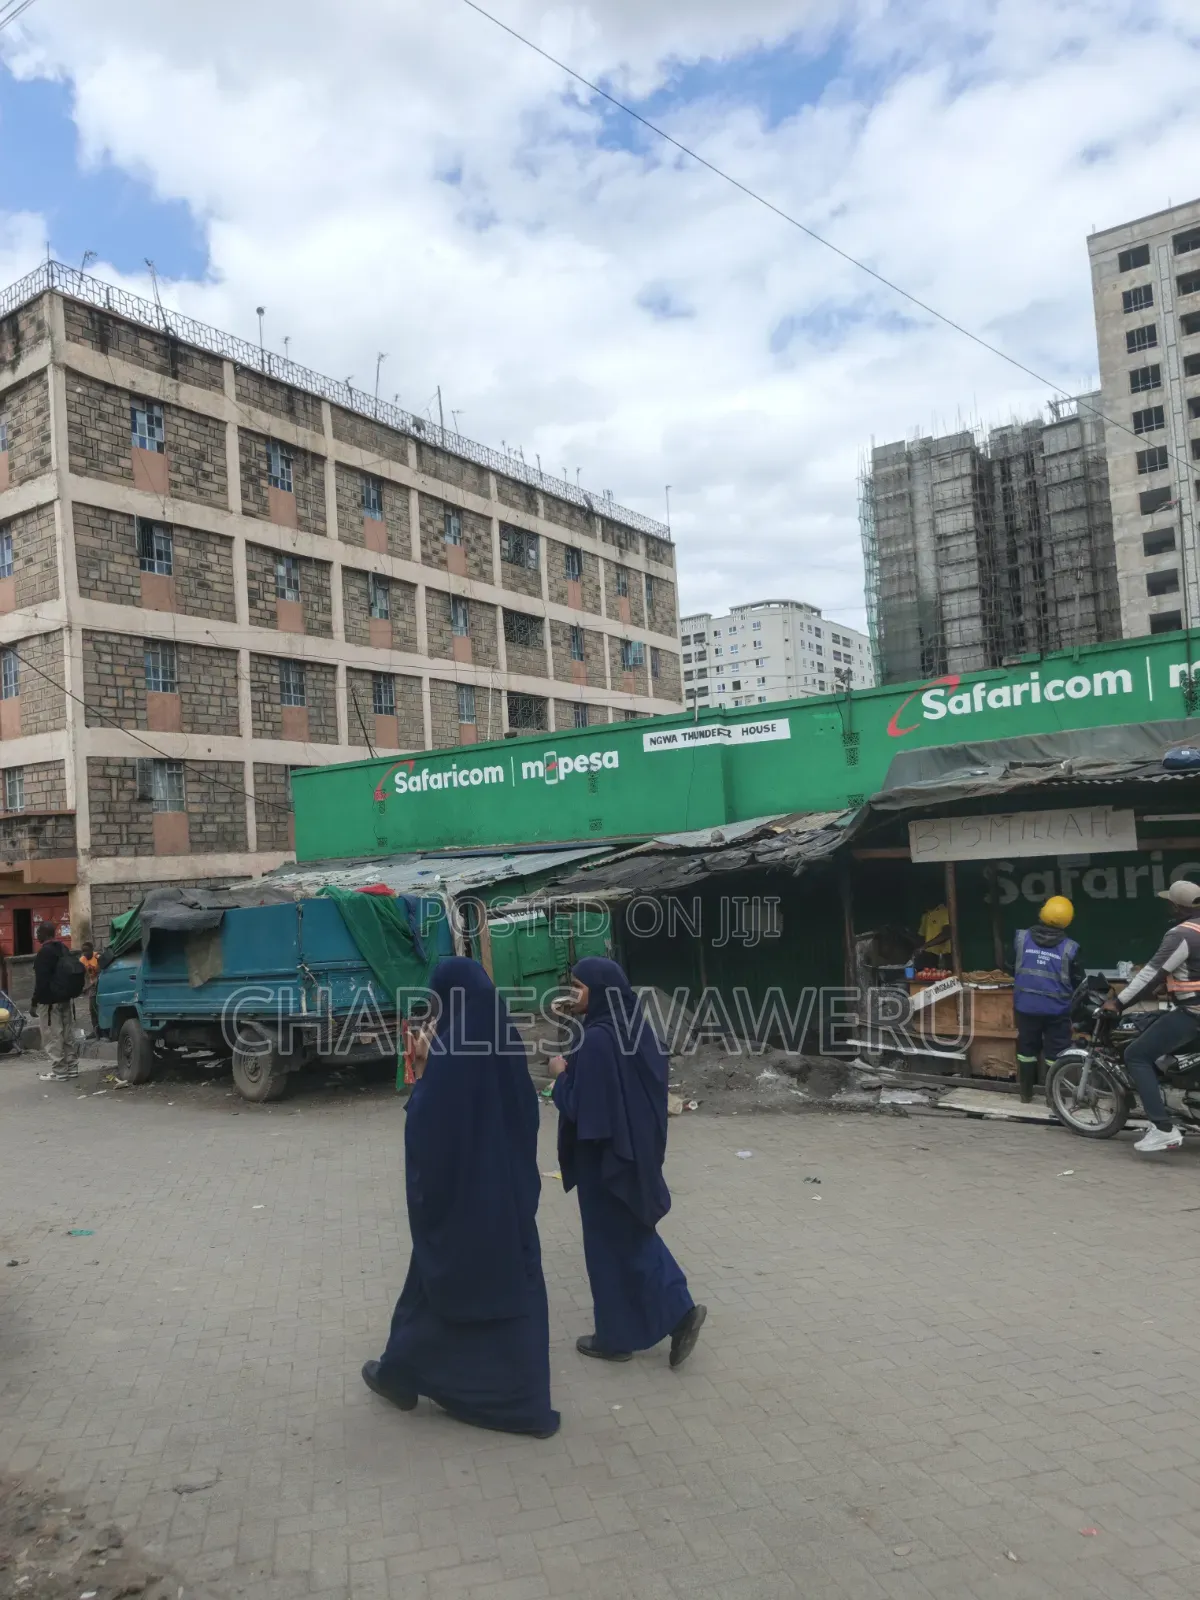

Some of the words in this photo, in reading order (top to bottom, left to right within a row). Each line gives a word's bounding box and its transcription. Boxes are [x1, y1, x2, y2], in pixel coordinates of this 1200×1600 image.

[921, 669, 1133, 720] Safaricom
[649, 733, 678, 746] NGWA
[681, 727, 732, 743] THUNDER
[741, 723, 777, 736] HOUSE
[394, 763, 504, 794] Safaricom
